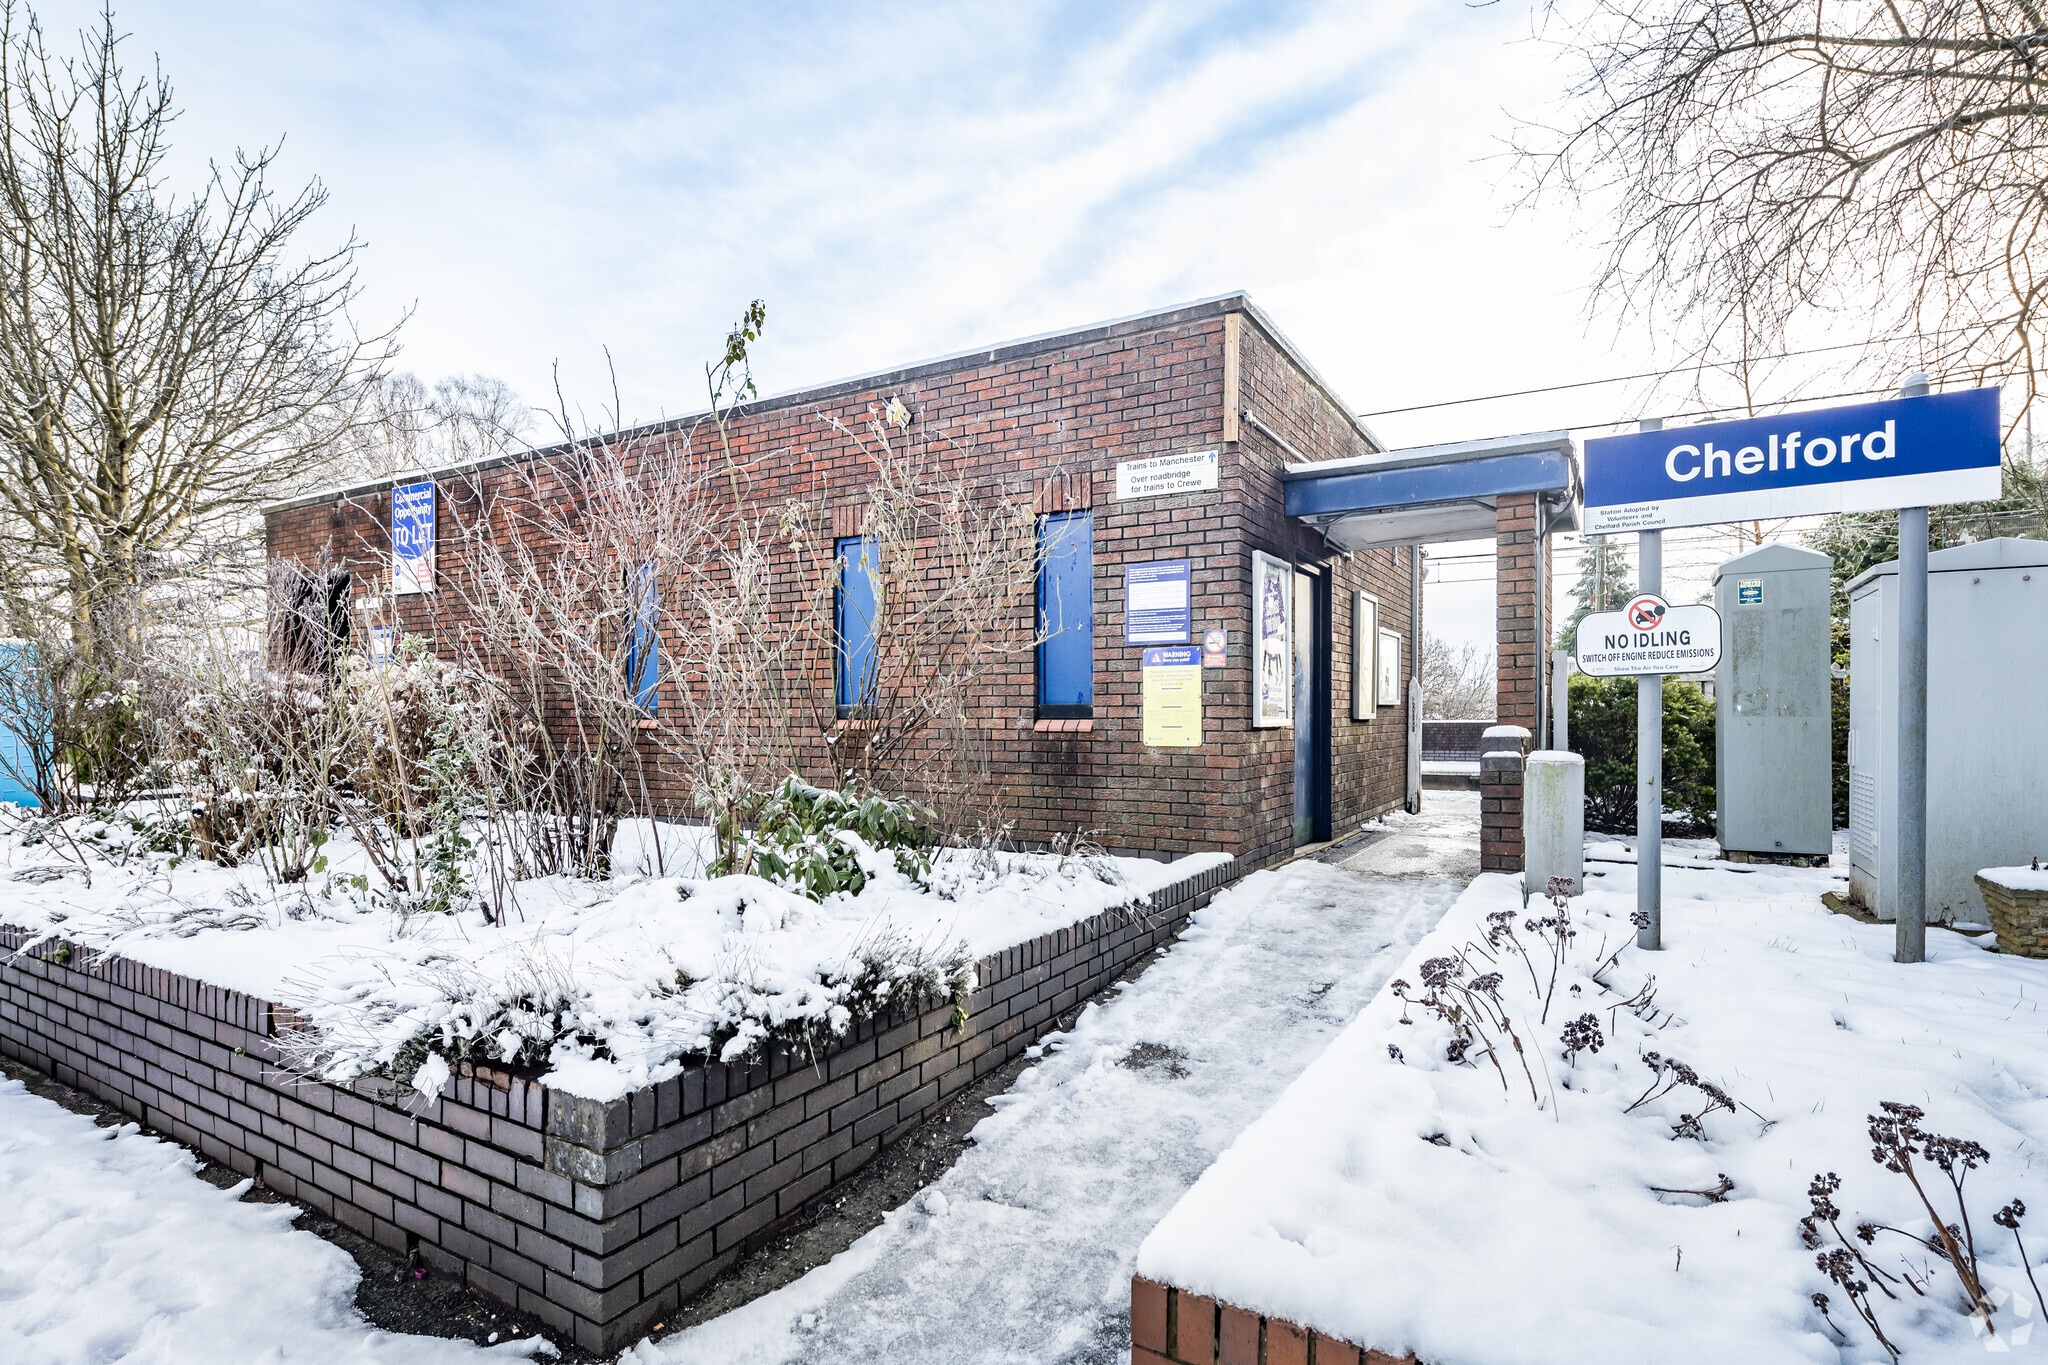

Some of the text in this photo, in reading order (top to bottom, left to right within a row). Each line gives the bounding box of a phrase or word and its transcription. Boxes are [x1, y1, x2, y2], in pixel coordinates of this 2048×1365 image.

[1665, 419, 1896, 482] Chelford
[1126, 454, 1205, 471] Trains to Manchester
[1130, 469, 1191, 484] Over roadbridge
[1131, 478, 1202, 493] for trains to Crewe
[1623, 505, 1650, 514] Adopted
[1651, 504, 1660, 512] by
[1594, 518, 1666, 530] Chelford Parish Council
[1607, 514, 1639, 522] Volunteers
[394, 526, 409, 547] TO
[1604, 630, 1691, 650] NO IDLING
[1162, 650, 1192, 658] WARNING
[1582, 648, 1715, 663] SWITCH OFF ENGINE REDUCE EMISSIONS
